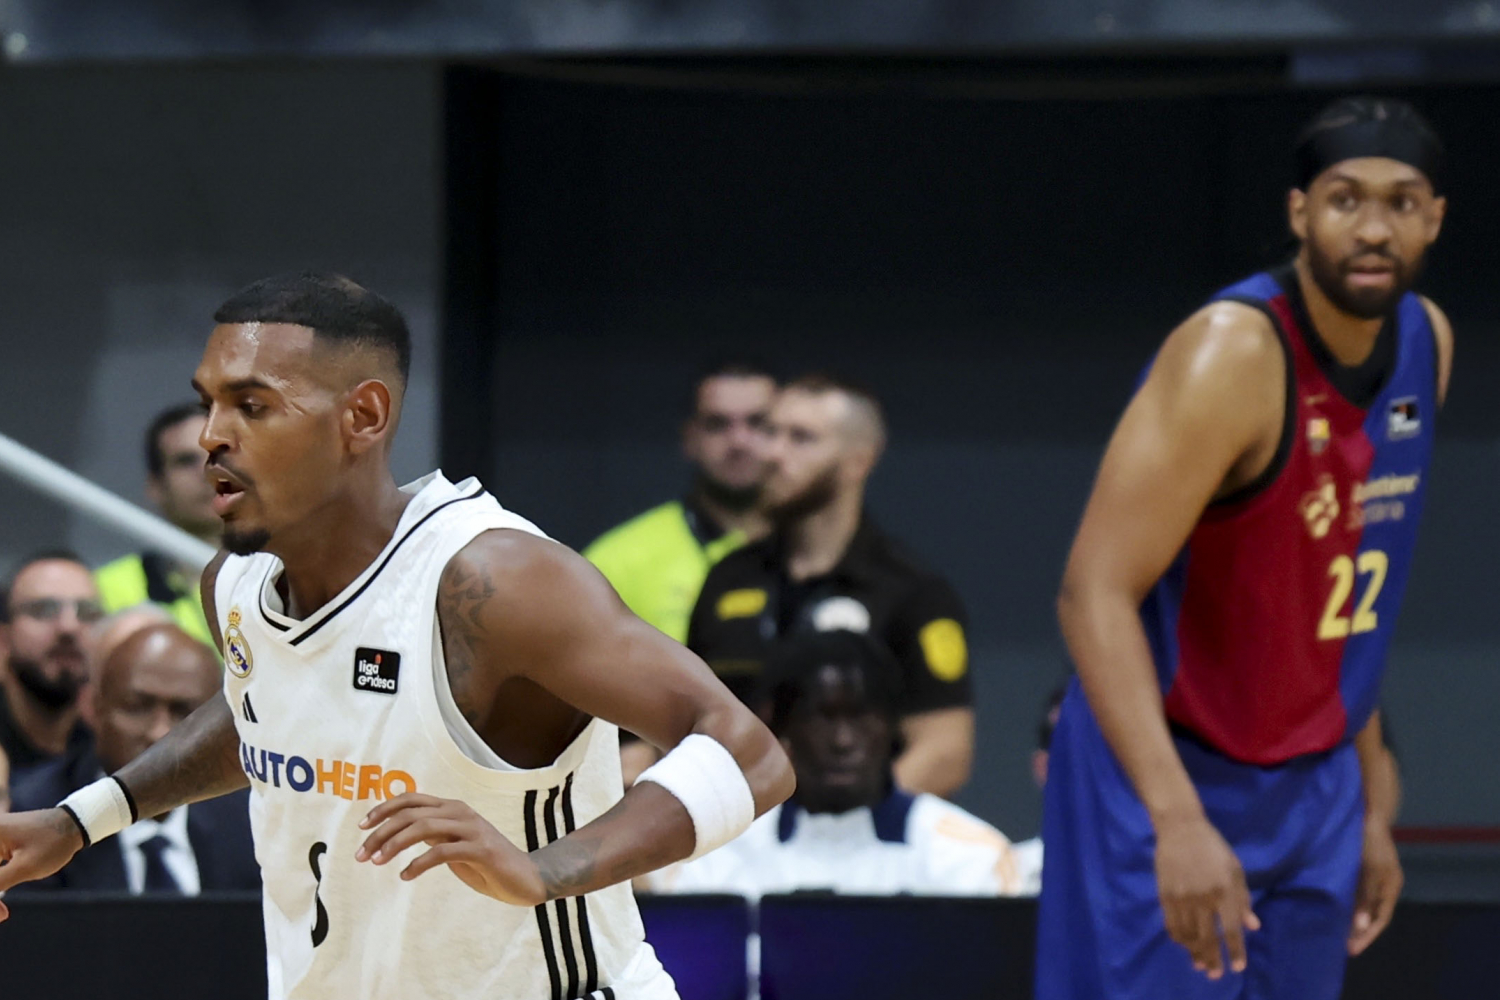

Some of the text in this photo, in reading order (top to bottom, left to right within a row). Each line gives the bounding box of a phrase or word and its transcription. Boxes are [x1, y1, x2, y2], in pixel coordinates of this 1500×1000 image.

[1316, 549, 1389, 641] 22
[357, 674, 396, 690] endesa
[358, 659, 380, 676] liga
[242, 741, 417, 801] AUTOHERO
